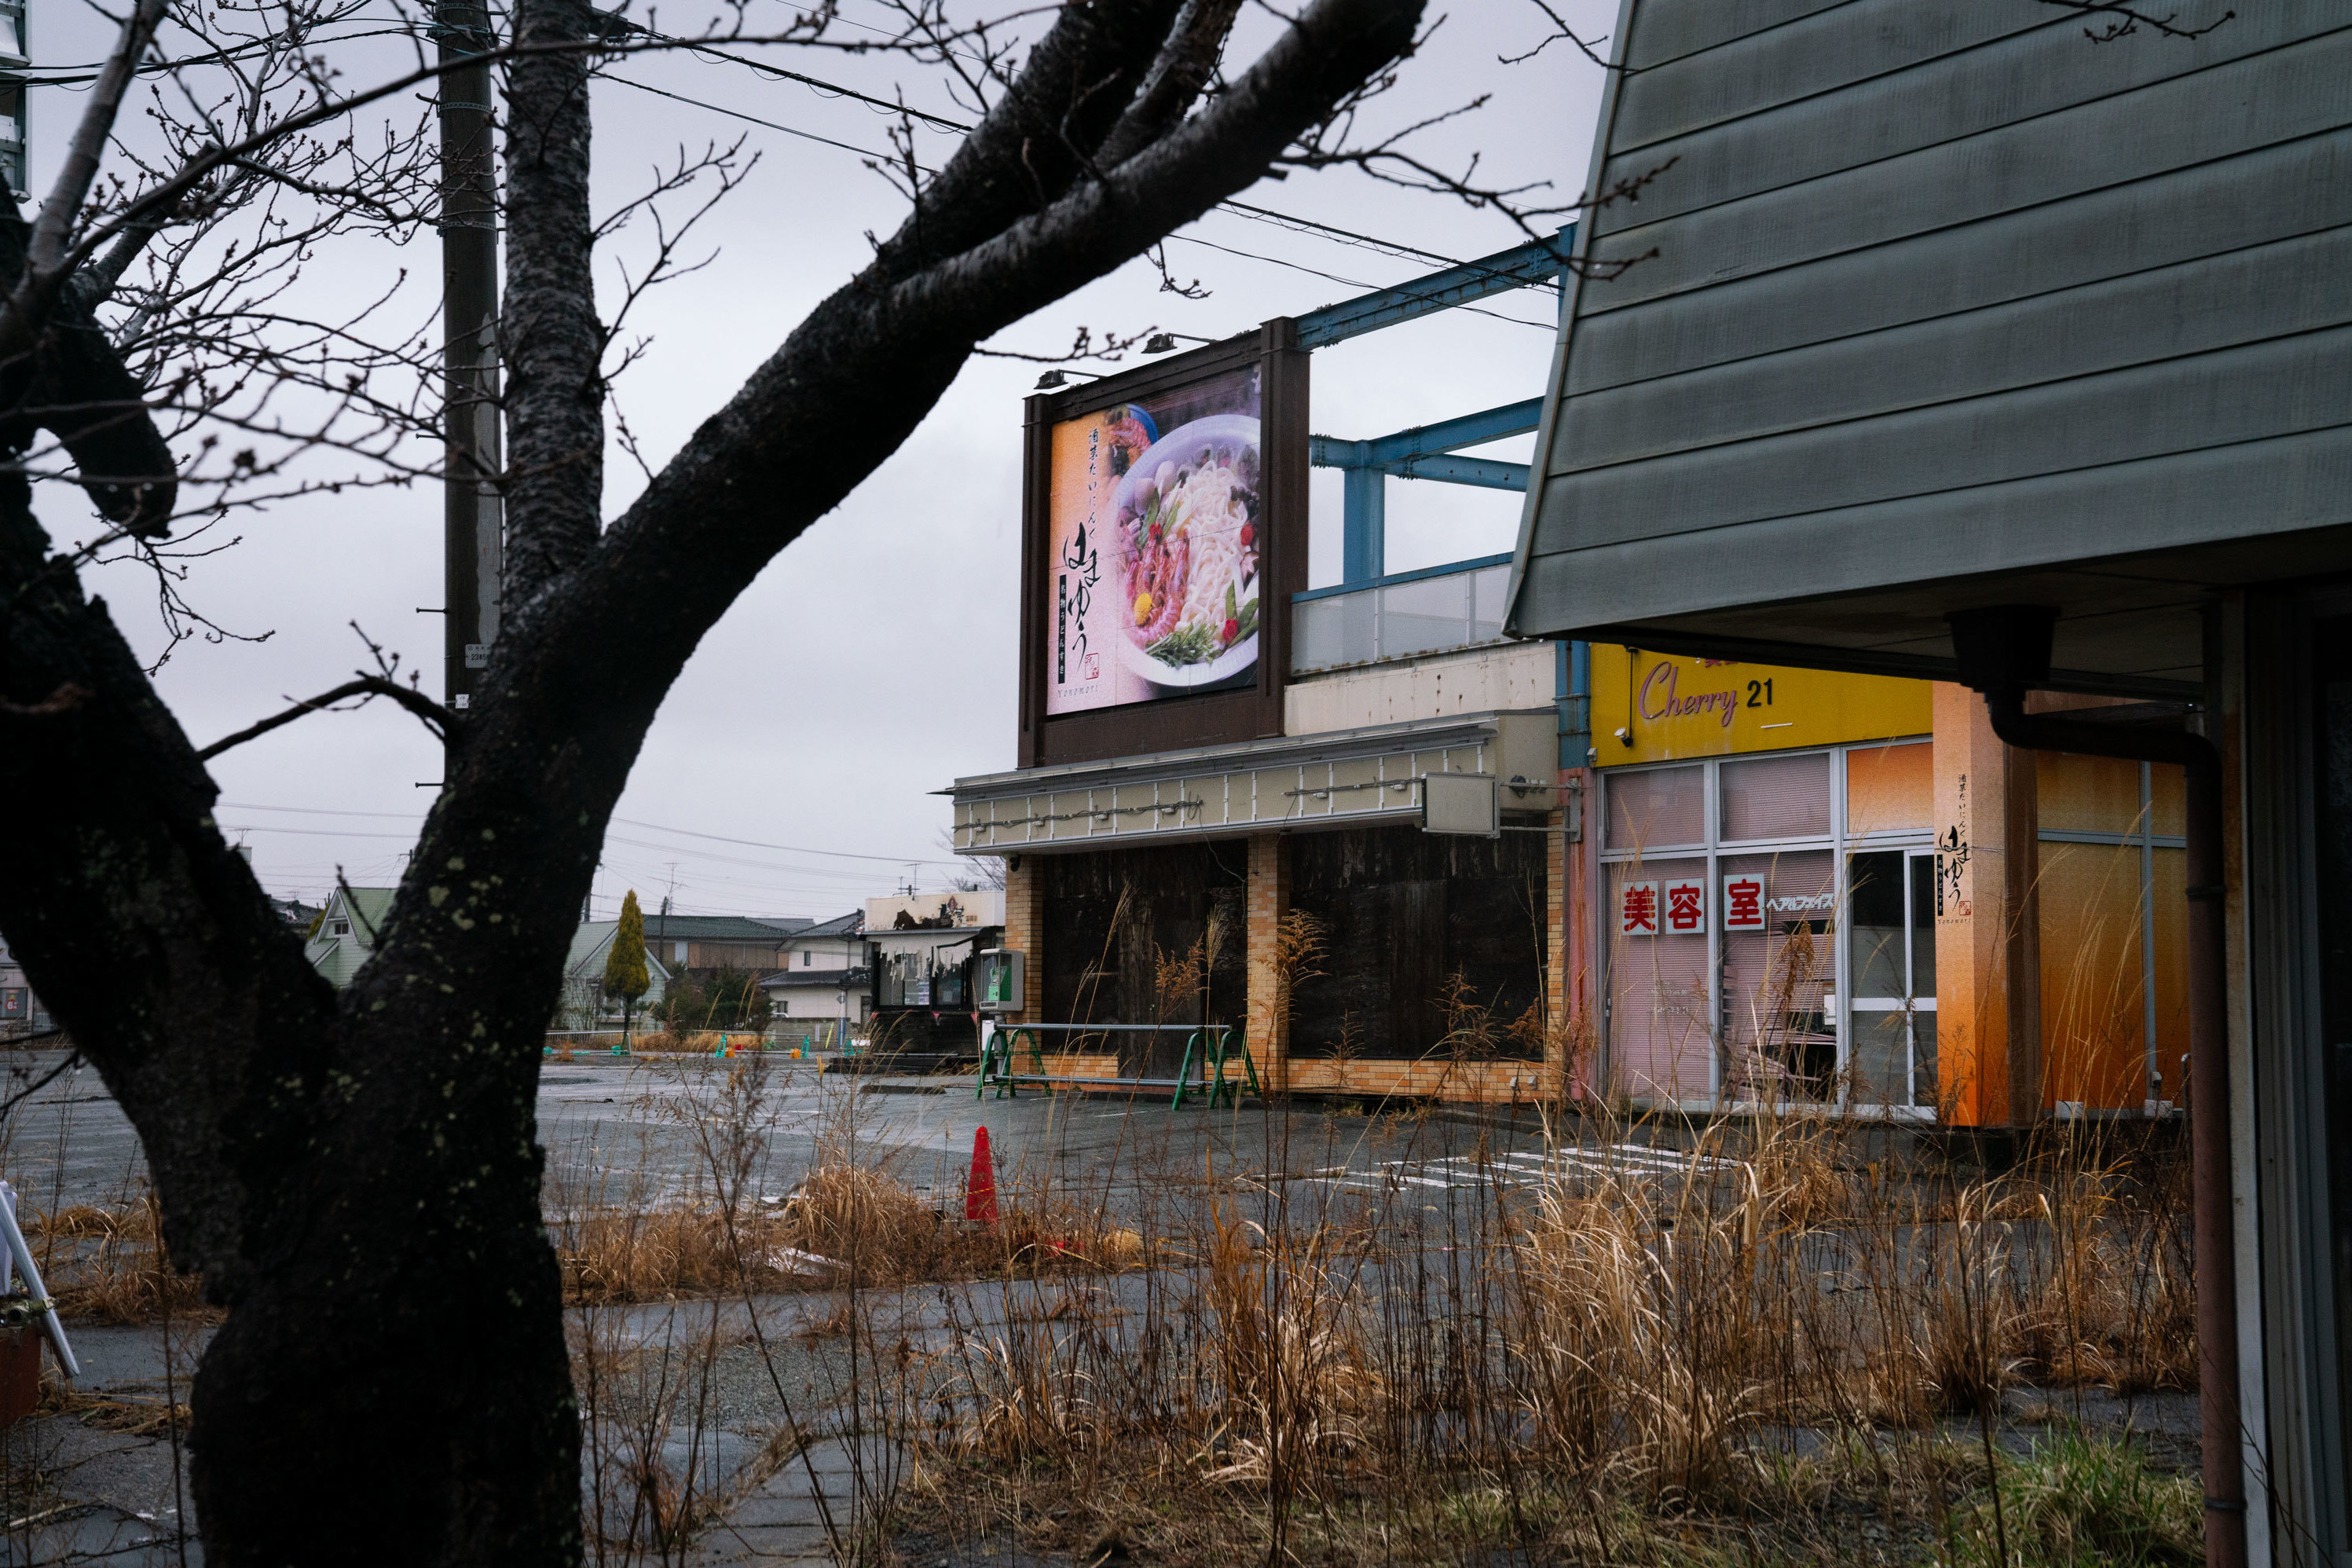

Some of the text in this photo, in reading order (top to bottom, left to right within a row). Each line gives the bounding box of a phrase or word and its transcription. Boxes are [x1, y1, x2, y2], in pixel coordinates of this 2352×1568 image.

[1063, 522, 1101, 676] はまゆう
[1638, 661, 1772, 727] Cherry 21
[1623, 878, 1763, 932] 美容室
[1939, 825, 1971, 911] はまゆう
